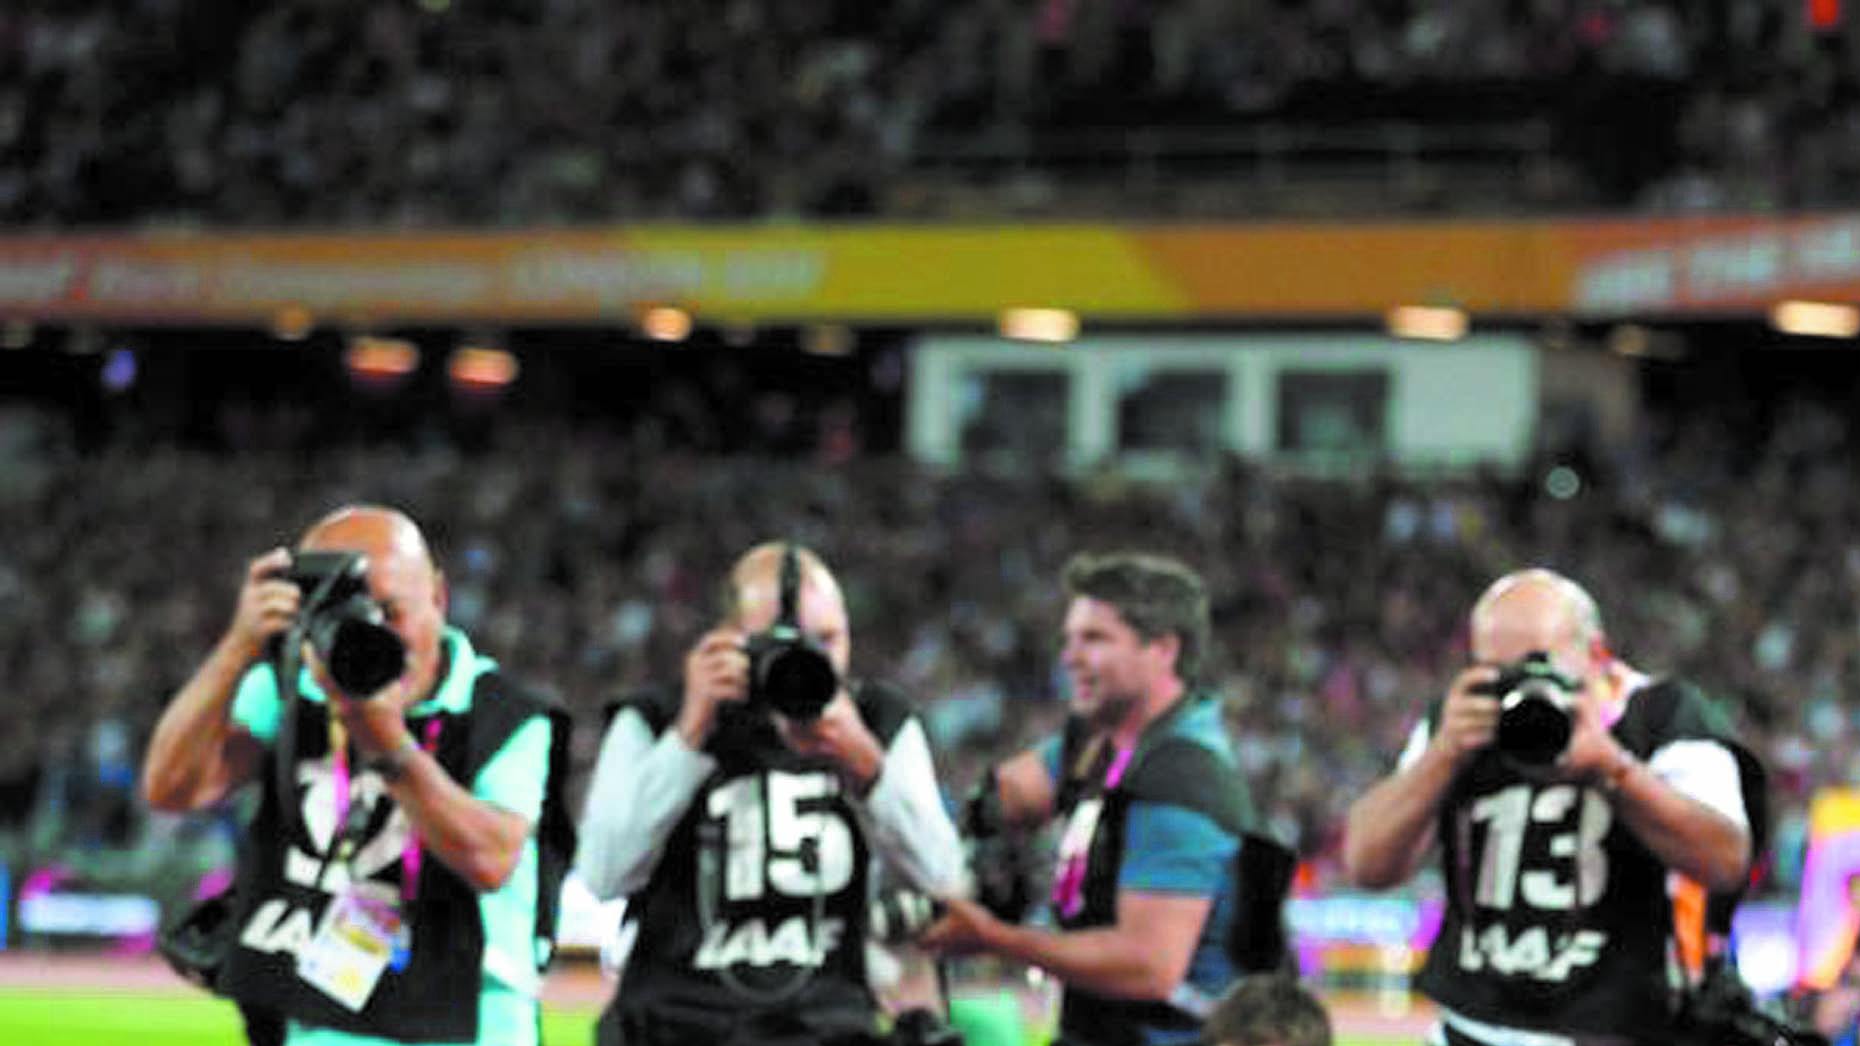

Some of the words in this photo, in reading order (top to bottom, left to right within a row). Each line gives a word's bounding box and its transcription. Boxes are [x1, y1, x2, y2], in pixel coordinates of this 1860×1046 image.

[707, 769, 854, 901] 15
[1471, 783, 1613, 910] 13
[693, 916, 847, 970] IAAF
